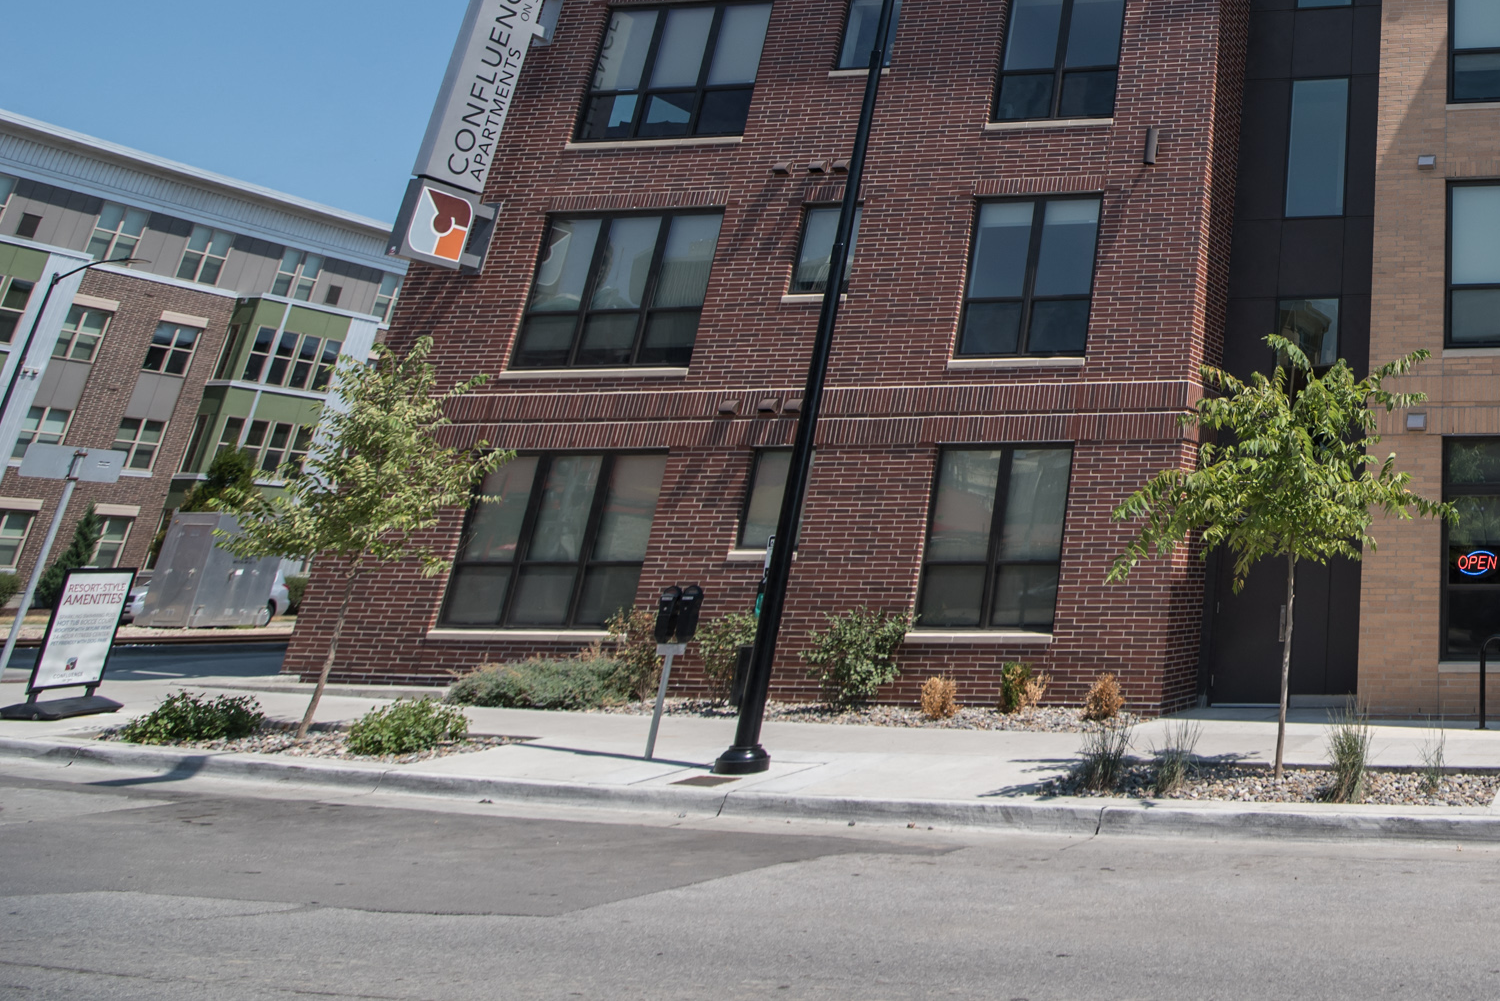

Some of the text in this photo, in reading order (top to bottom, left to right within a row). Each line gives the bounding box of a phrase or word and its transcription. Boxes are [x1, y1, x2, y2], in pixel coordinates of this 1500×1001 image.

[520, 4, 533, 22] ON
[470, 47, 522, 183] APARTMENTS
[1457, 555, 1498, 570] OPEN
[68, 582, 127, 593] RESORT-STYLE
[63, 593, 124, 606] AMENITIES
